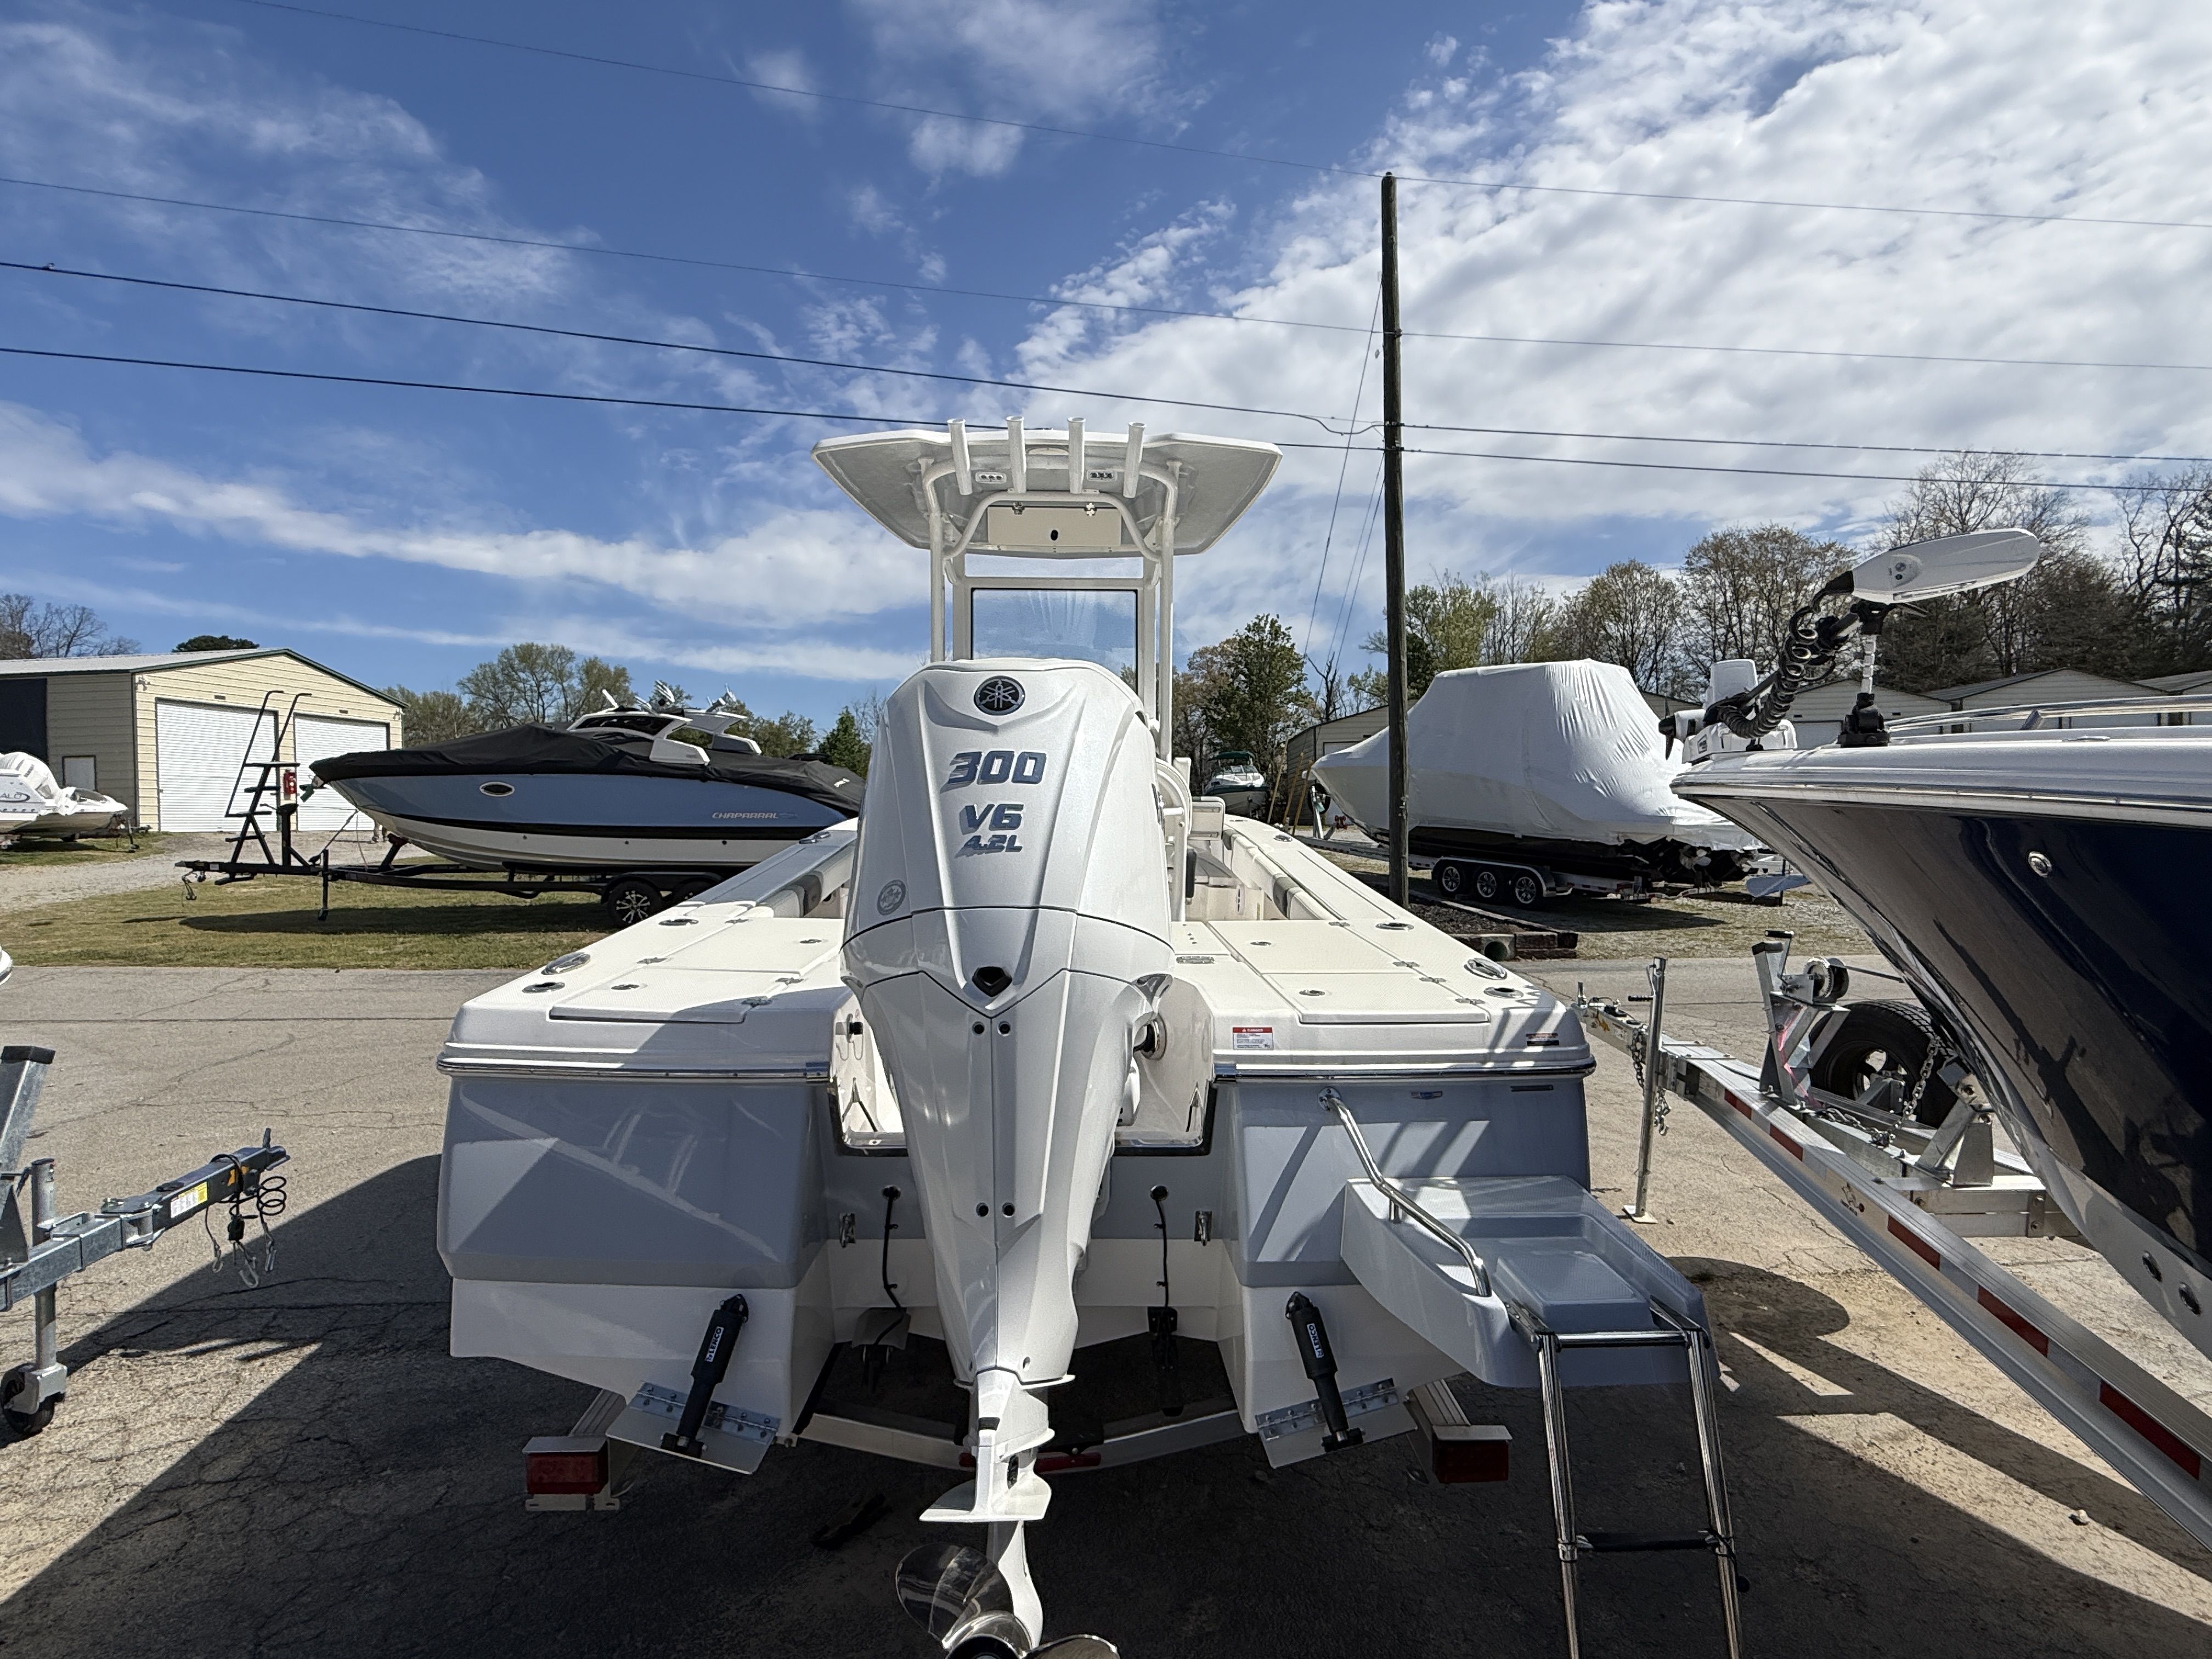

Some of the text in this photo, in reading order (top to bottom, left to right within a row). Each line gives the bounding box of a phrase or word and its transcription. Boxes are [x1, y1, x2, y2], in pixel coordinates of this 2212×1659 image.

[948, 751, 1047, 785] 300
[964, 804, 1024, 830] V6
[963, 834, 1023, 853] 4.2L
[708, 1328, 722, 1353] LENCO
[1308, 1324, 1322, 1351] LENCO
